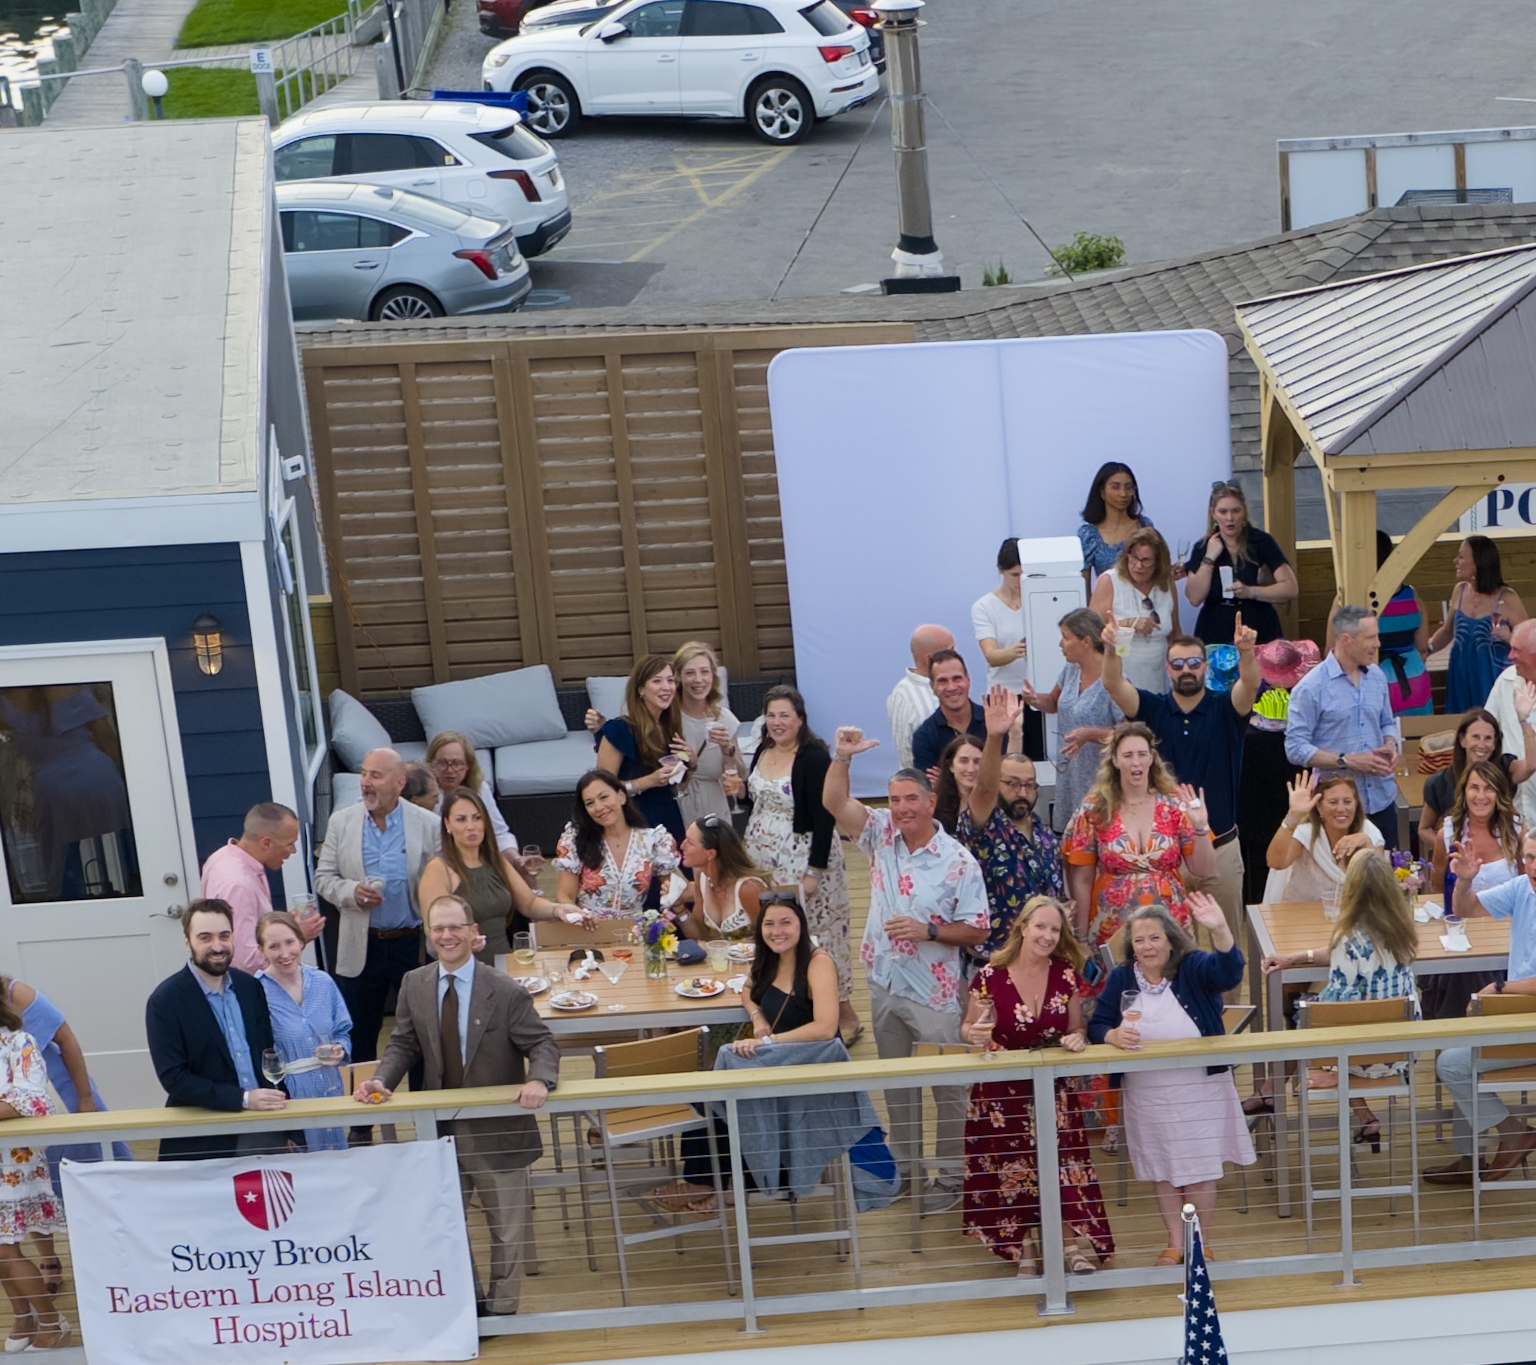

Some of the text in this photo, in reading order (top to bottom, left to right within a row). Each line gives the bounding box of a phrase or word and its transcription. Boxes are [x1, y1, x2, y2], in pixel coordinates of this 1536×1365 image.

[170, 1234, 374, 1275] Stony Brook
[106, 1269, 446, 1314] Eastern Long Island
[210, 1309, 353, 1348] Hospital
